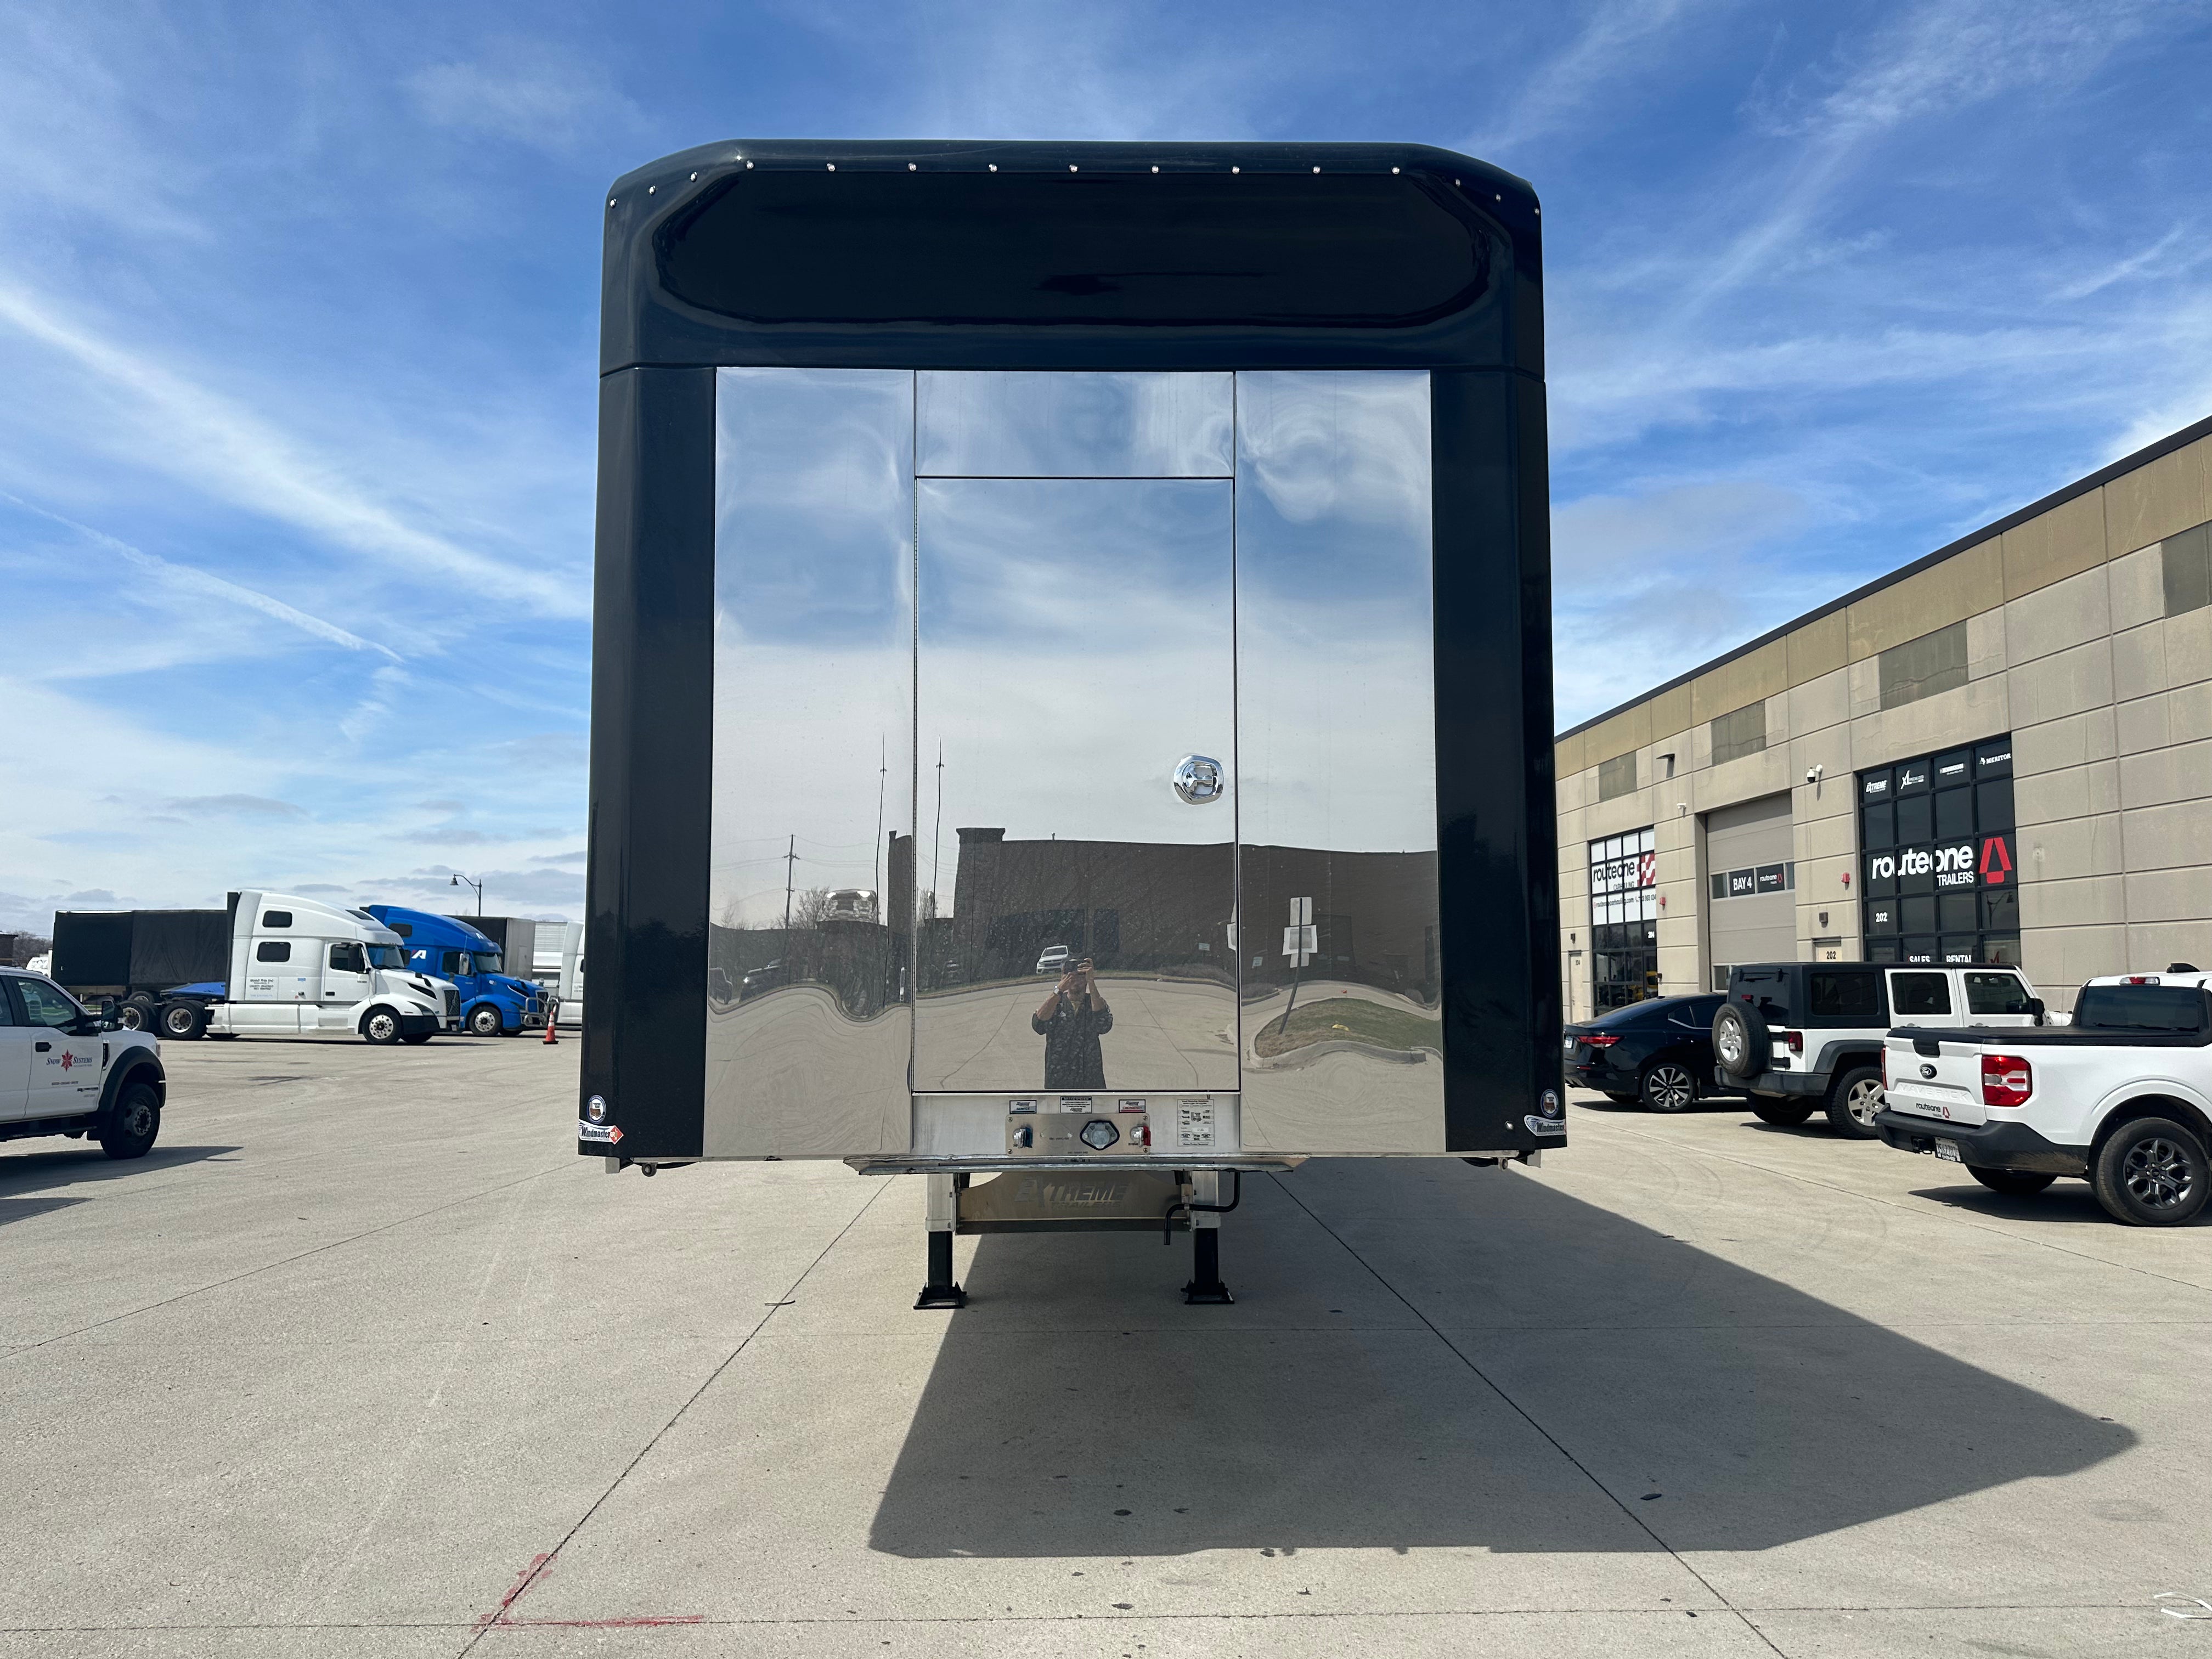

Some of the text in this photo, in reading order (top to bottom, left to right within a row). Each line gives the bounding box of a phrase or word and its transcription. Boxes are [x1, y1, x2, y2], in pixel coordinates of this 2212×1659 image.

[1986, 753, 2011, 764] MERITOR
[1865, 780, 1887, 793] EXTREME
[1593, 861, 1635, 882] routeone
[1733, 876, 1752, 890] BAY 4
[1937, 871, 1974, 887] TRAILERS
[1875, 912, 1888, 923] 202
[1826, 951, 1836, 960] 202
[1946, 955, 1971, 963] RENTAL
[1900, 1084, 1968, 1102] MAVERICK
[1916, 1103, 1941, 1112] routeone
[581, 1125, 611, 1138] Windmaster
[1537, 1121, 1564, 1132] Windmaster
